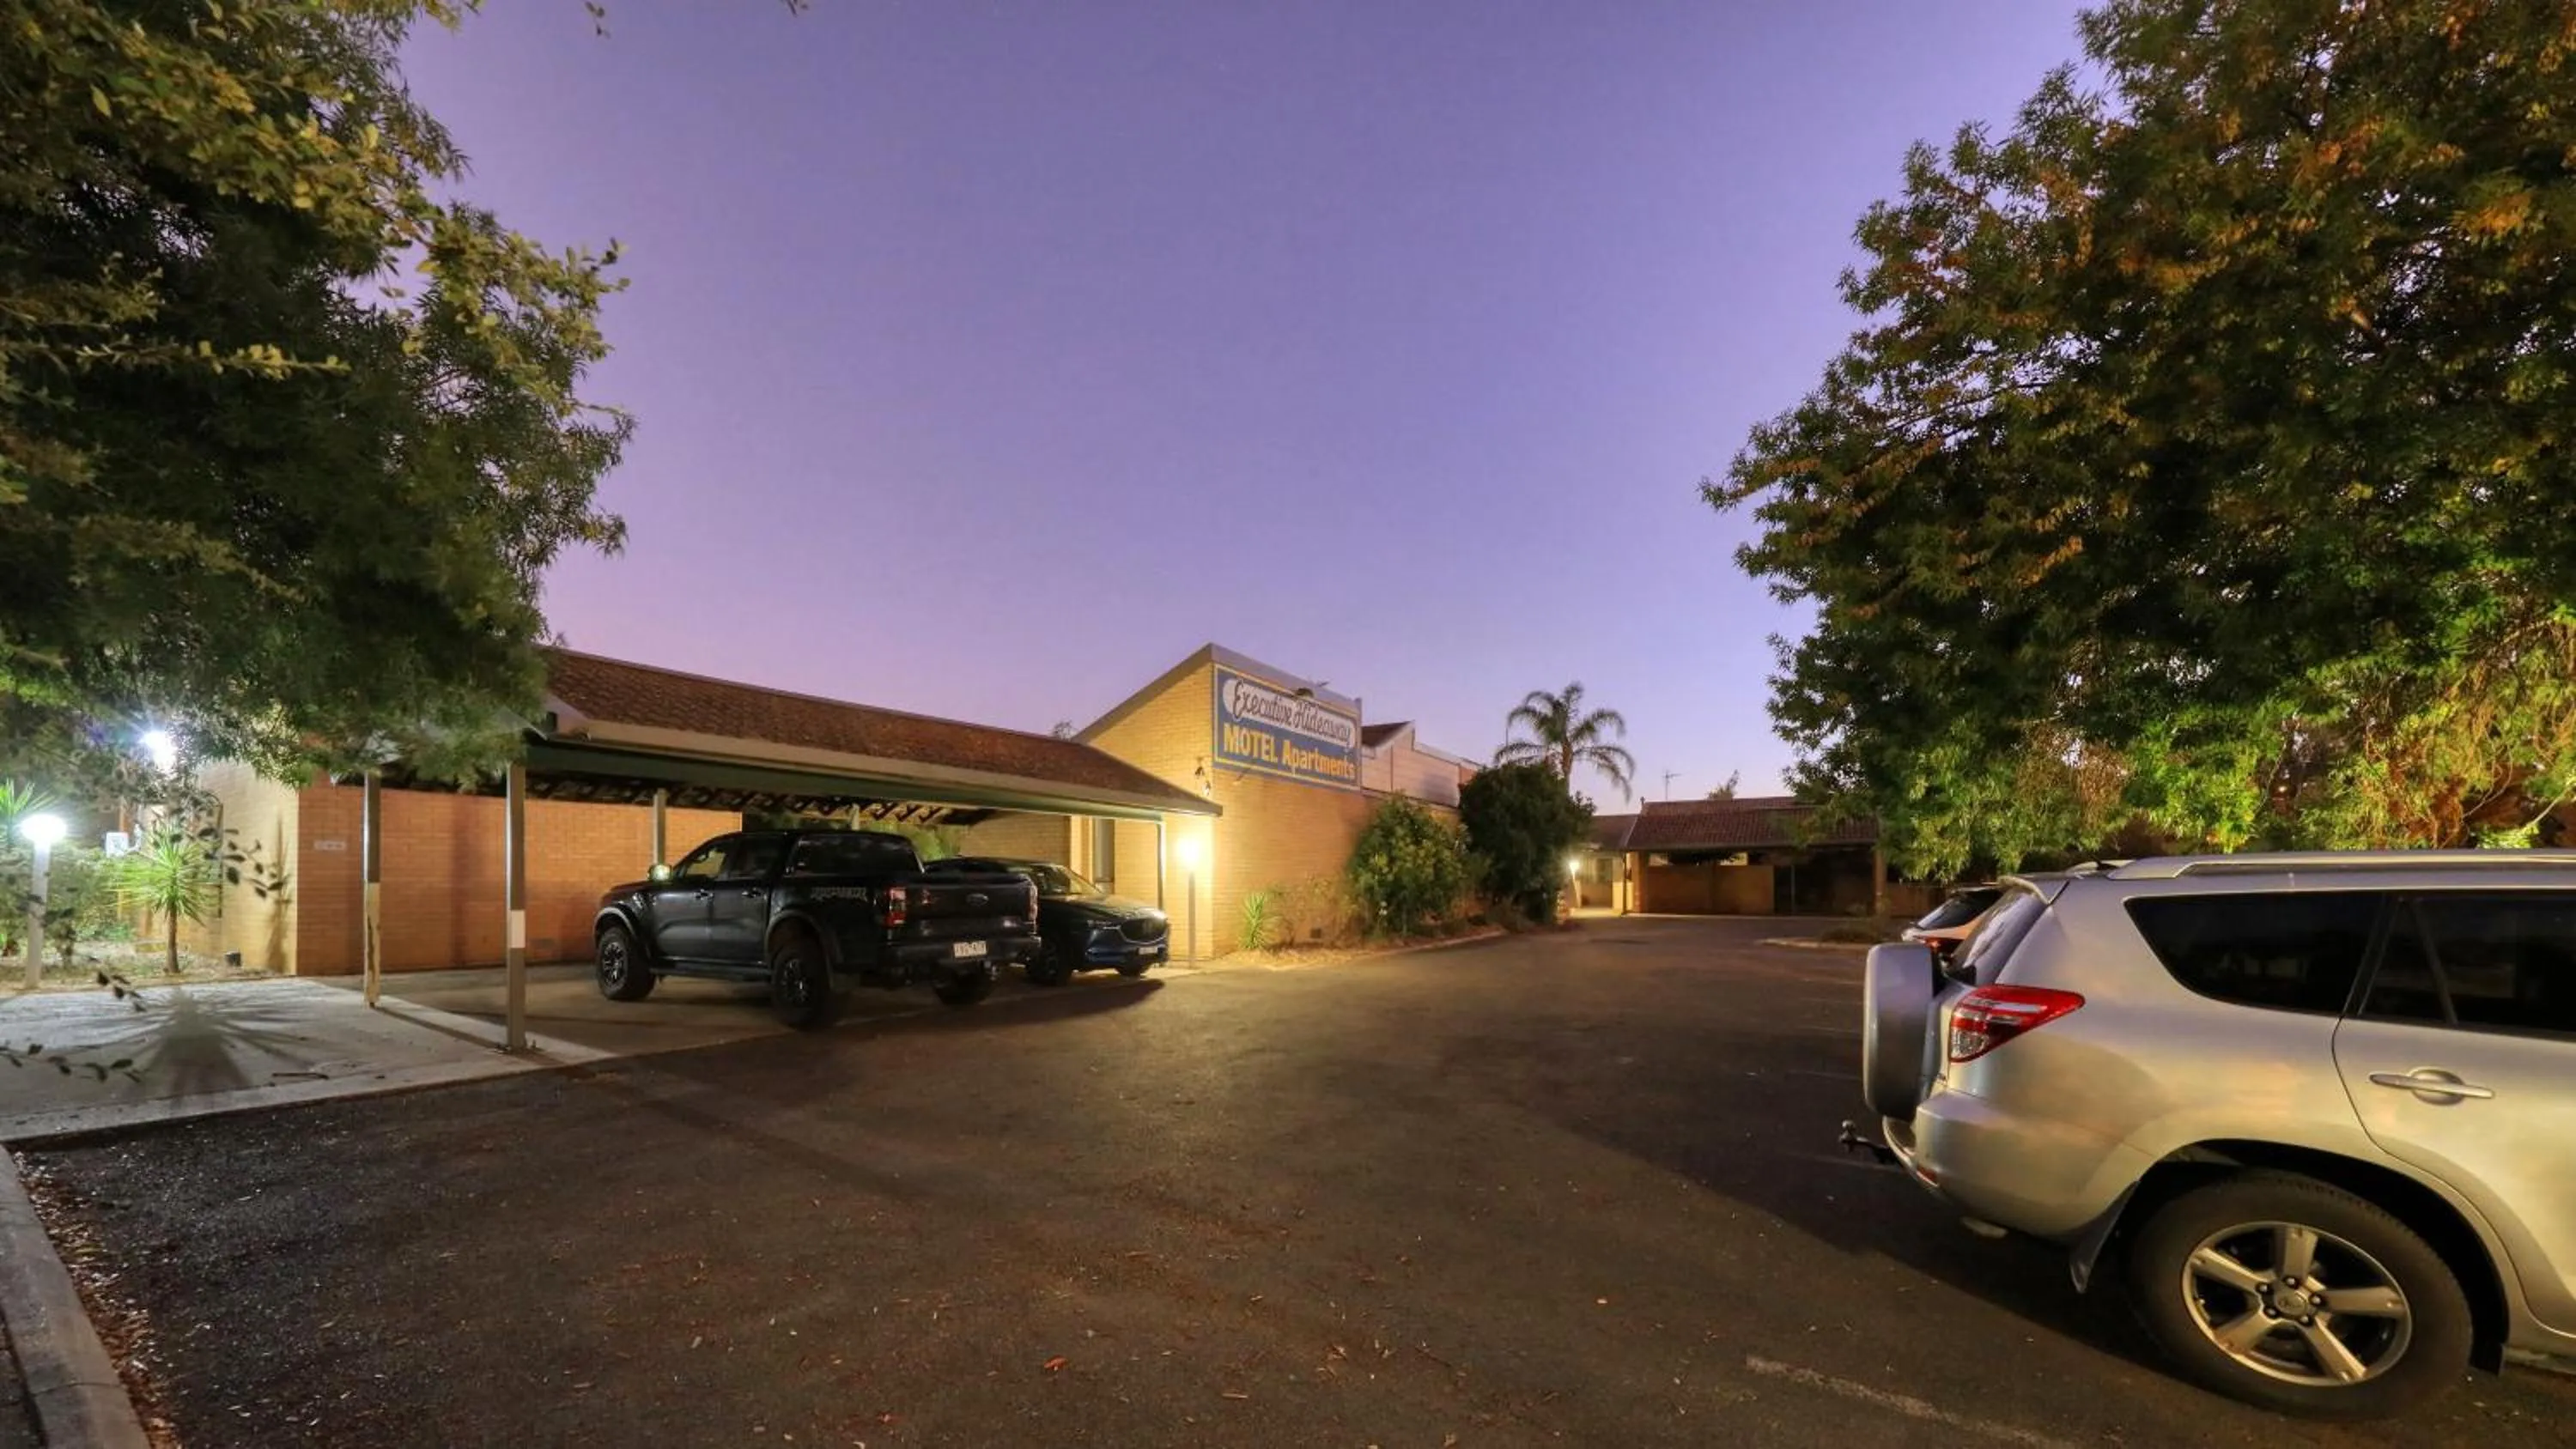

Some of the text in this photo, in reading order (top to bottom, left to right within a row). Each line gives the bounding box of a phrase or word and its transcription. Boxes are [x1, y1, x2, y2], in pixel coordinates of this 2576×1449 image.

[1233, 680, 1291, 726] Executive
[1224, 724, 1355, 777] MOTEL Apartments
